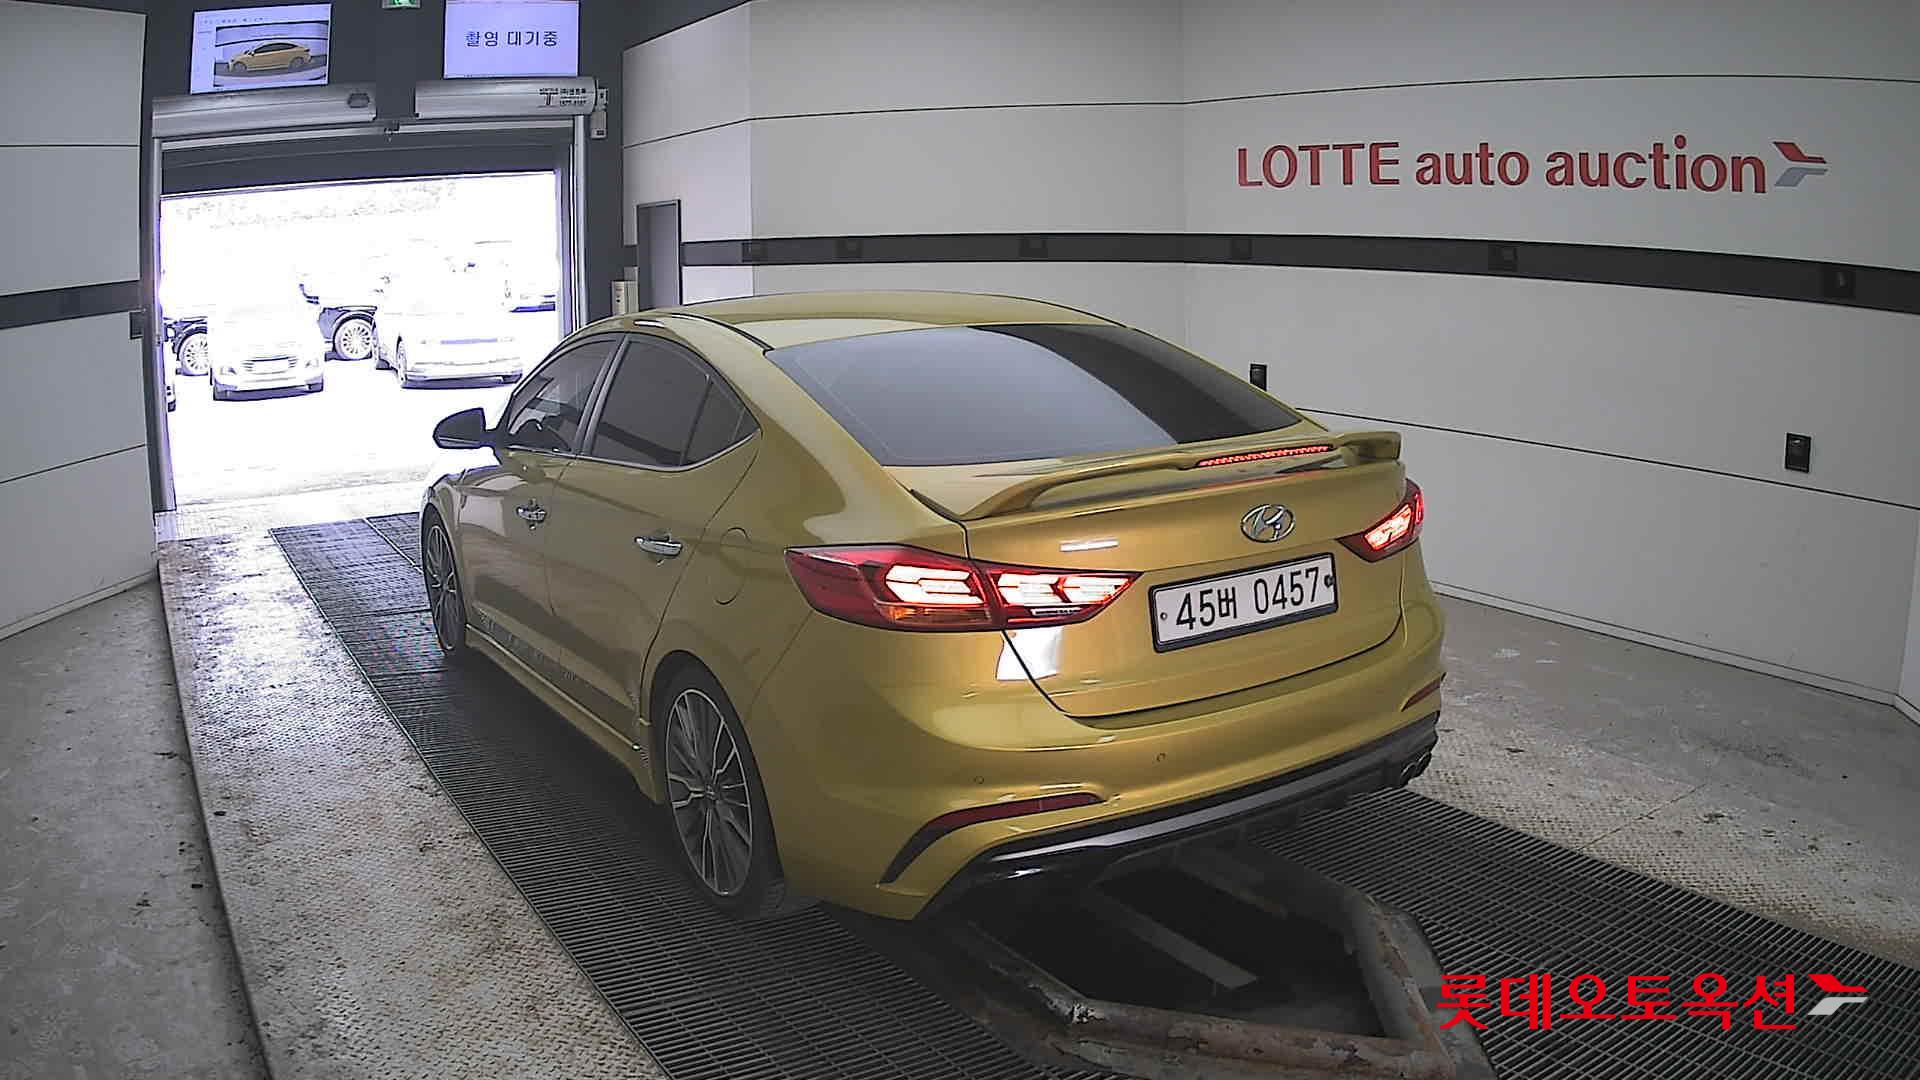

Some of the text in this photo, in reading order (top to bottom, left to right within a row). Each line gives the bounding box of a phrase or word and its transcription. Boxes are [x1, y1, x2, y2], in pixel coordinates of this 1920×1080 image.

[507, 31, 558, 47] 대기중
[1237, 134, 1766, 194] LOTTE auto auction
[1176, 566, 1319, 630] 45버 0457
